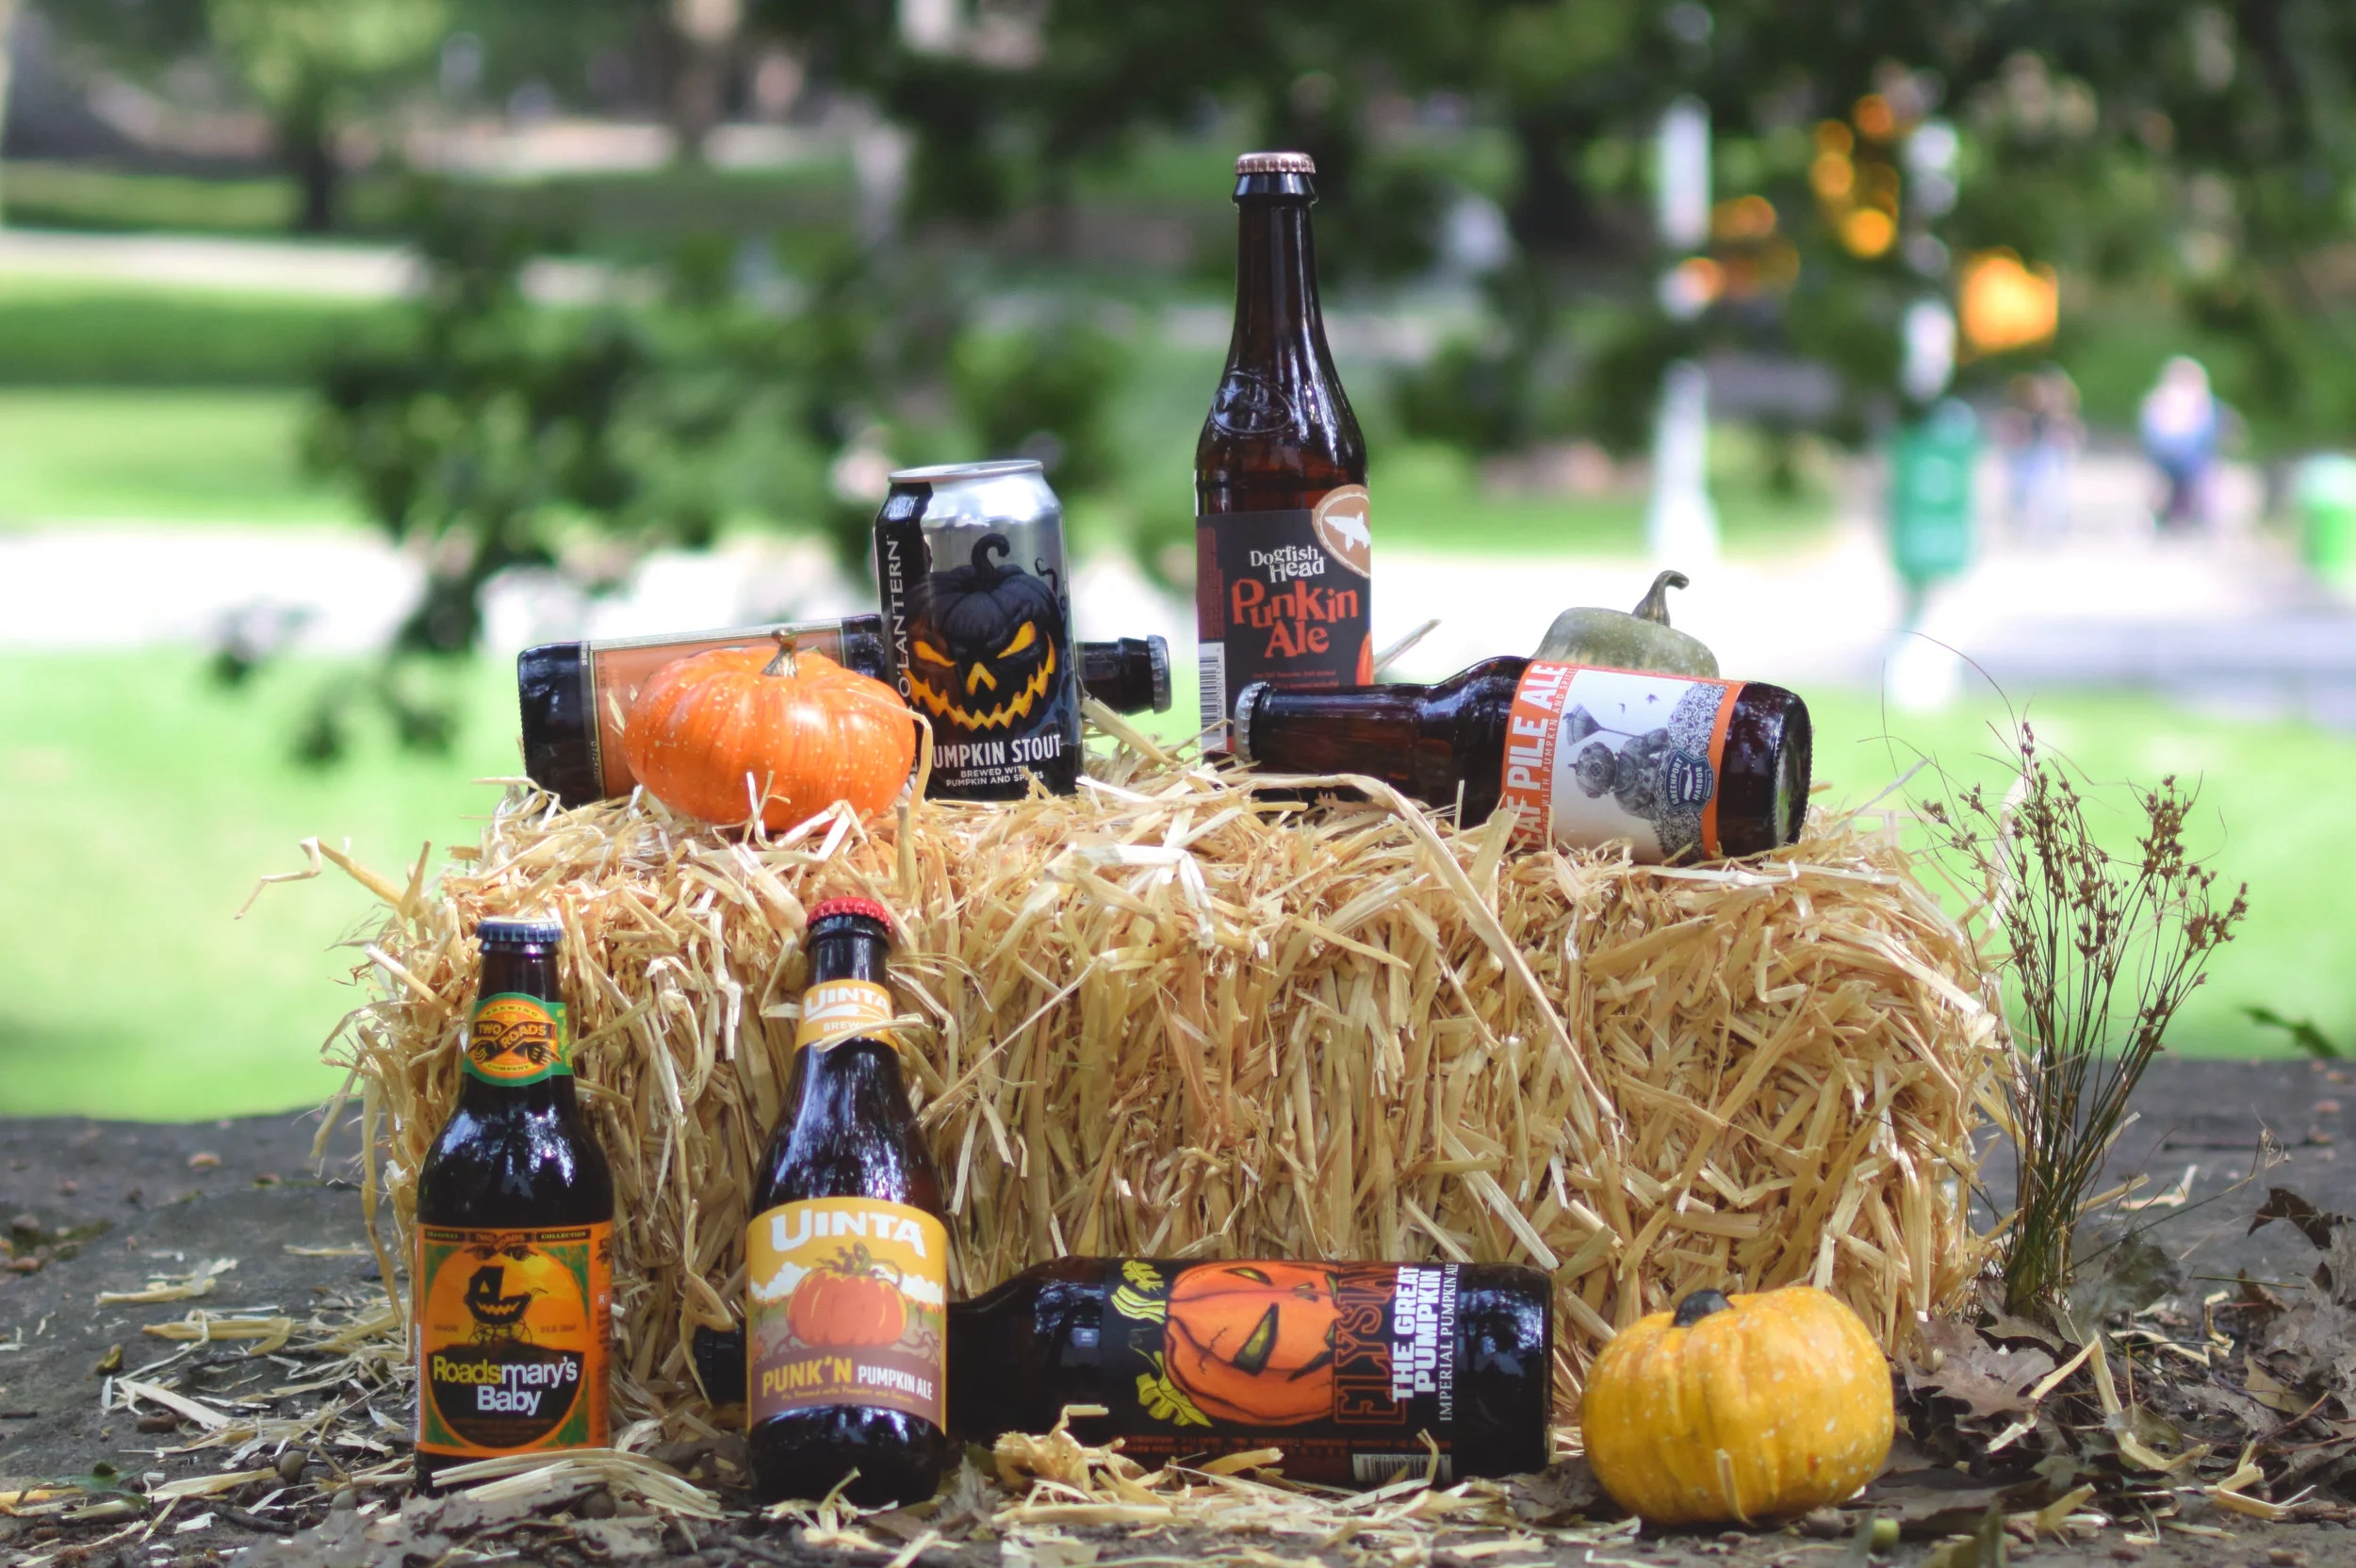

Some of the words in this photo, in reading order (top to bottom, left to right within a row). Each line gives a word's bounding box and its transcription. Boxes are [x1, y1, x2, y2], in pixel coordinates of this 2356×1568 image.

[1250, 545, 1318, 567] Dogfish
[1268, 556, 1325, 583] Head
[886, 539, 911, 698] O'LANTERN
[1231, 578, 1358, 629] Punkin
[1264, 620, 1330, 659] Ale
[1519, 663, 1568, 711] ALE
[1560, 667, 1578, 691] SPICES
[1554, 694, 1565, 714] AND
[932, 741, 1006, 769] UMPKIN
[1011, 734, 1061, 763] STOUT
[1508, 716, 1548, 790] PILE
[1543, 720, 1558, 772] PUMPKIN
[946, 777, 987, 788] PUMPKIN
[990, 774, 1011, 785] AND
[1012, 771, 1044, 782] SPES
[960, 767, 1002, 778] BREWED
[1542, 778, 1551, 806] WITH
[1669, 757, 1683, 805] GREENPORT
[1693, 765, 1703, 800] HARBOR
[1507, 795, 1546, 851] EAF
[805, 987, 892, 1020] UINTA
[479, 1023, 502, 1035] TWO
[500, 1024, 547, 1048] ROADS
[771, 1209, 926, 1259] UINTA
[1446, 1264, 1459, 1275] ALE
[1394, 1266, 1420, 1334] GREAT
[1440, 1277, 1457, 1337] PUMPKIN
[1414, 1270, 1442, 1393] PUMPKIN
[433, 1355, 578, 1389] Roadsmary's
[762, 1355, 853, 1398] PUNK'N
[858, 1364, 915, 1393] PUMPKIN
[916, 1379, 933, 1401] ALE
[1392, 1342, 1415, 1403] THE
[1439, 1341, 1453, 1422] IMPERIAL
[477, 1385, 542, 1416] Baby
